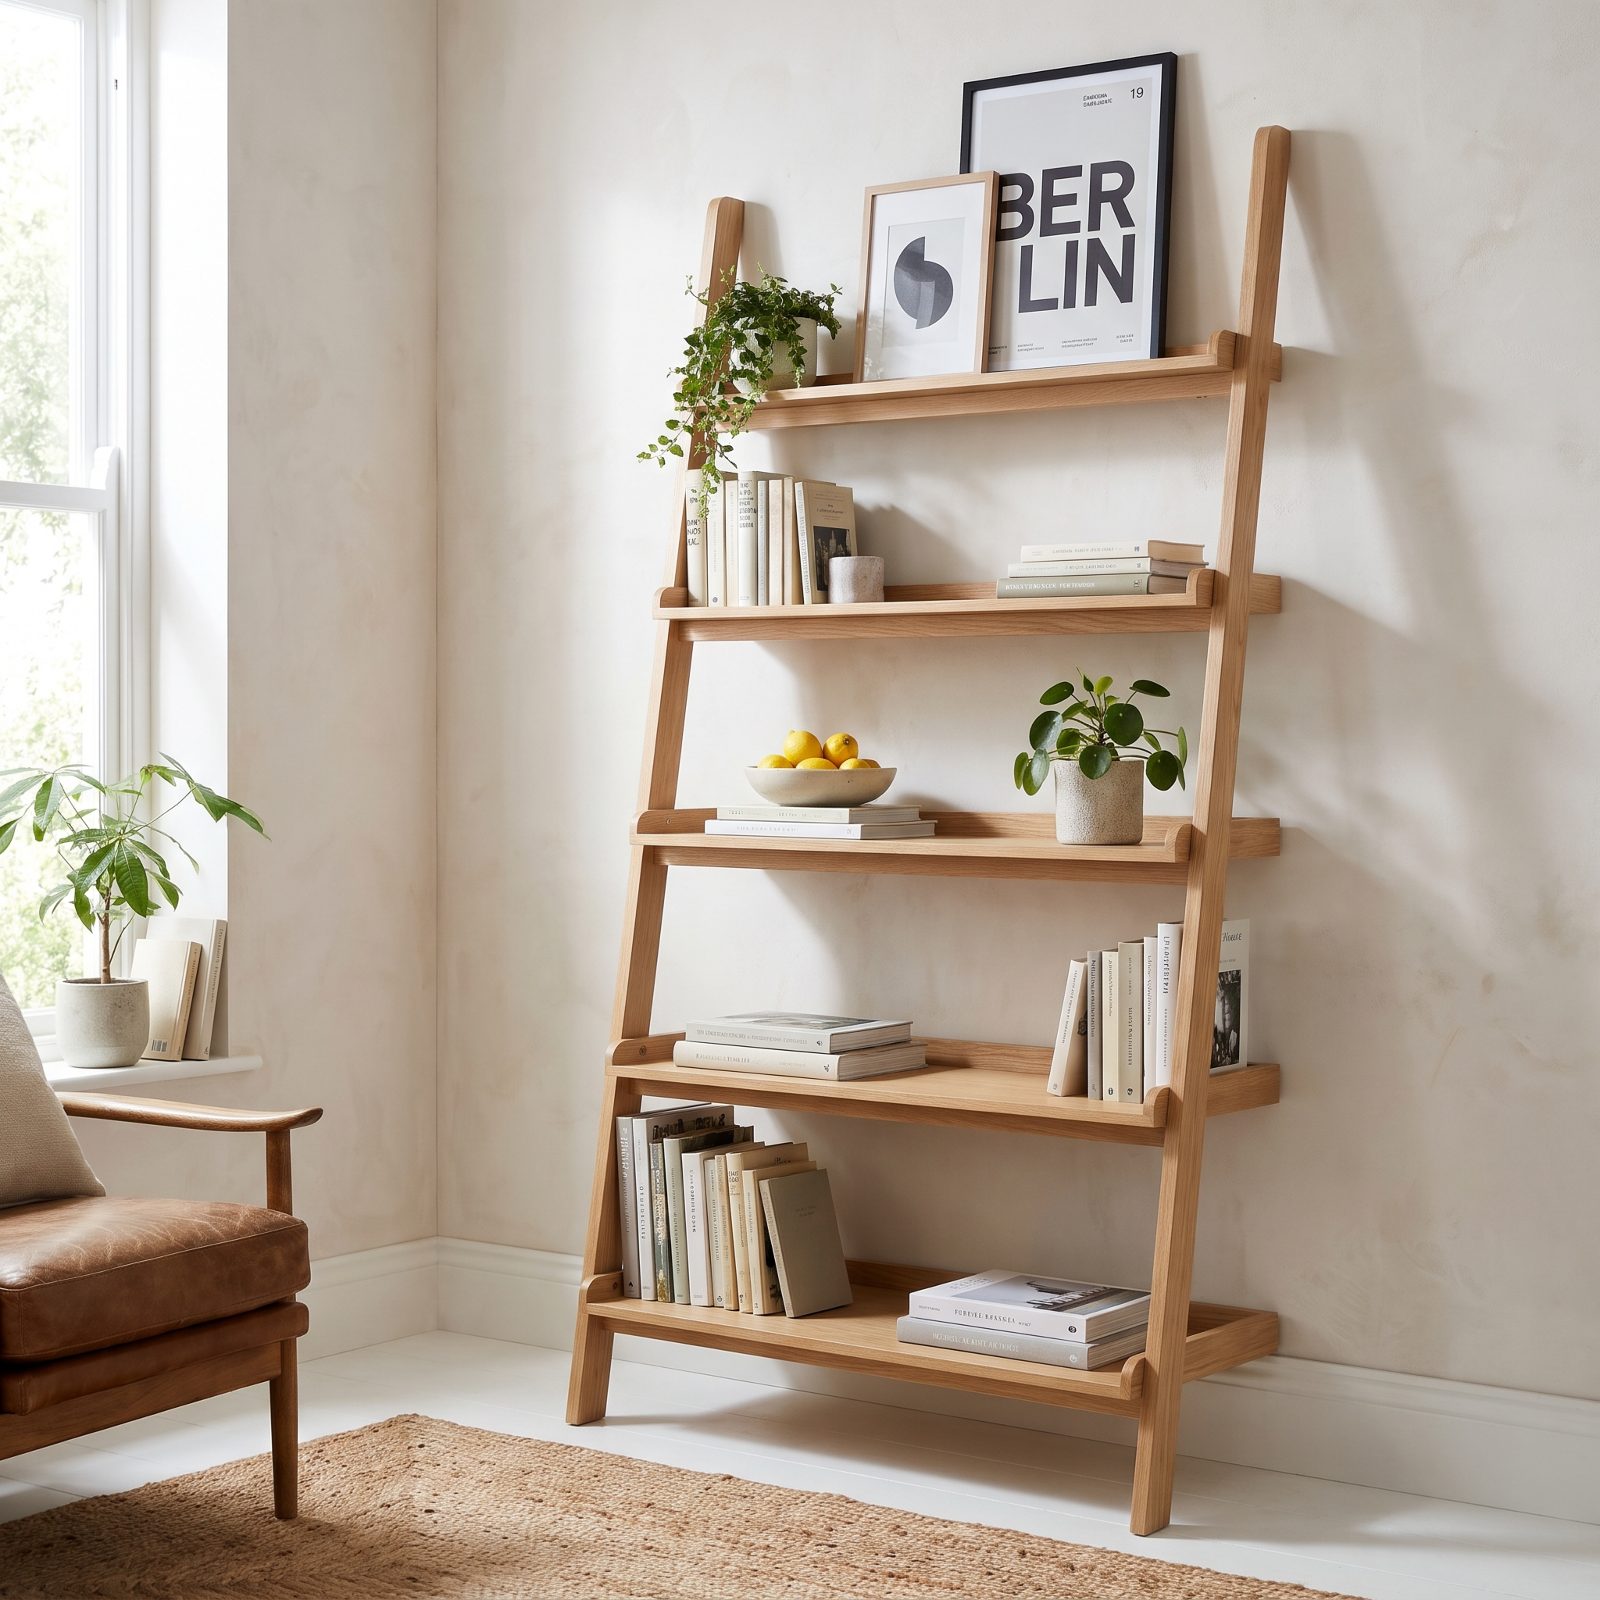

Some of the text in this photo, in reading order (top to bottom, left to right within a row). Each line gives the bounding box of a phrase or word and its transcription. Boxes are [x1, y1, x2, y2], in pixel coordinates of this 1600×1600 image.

[1130, 86, 1144, 99] 19
[996, 160, 1135, 242] BER
[1018, 234, 1136, 313] LIN
